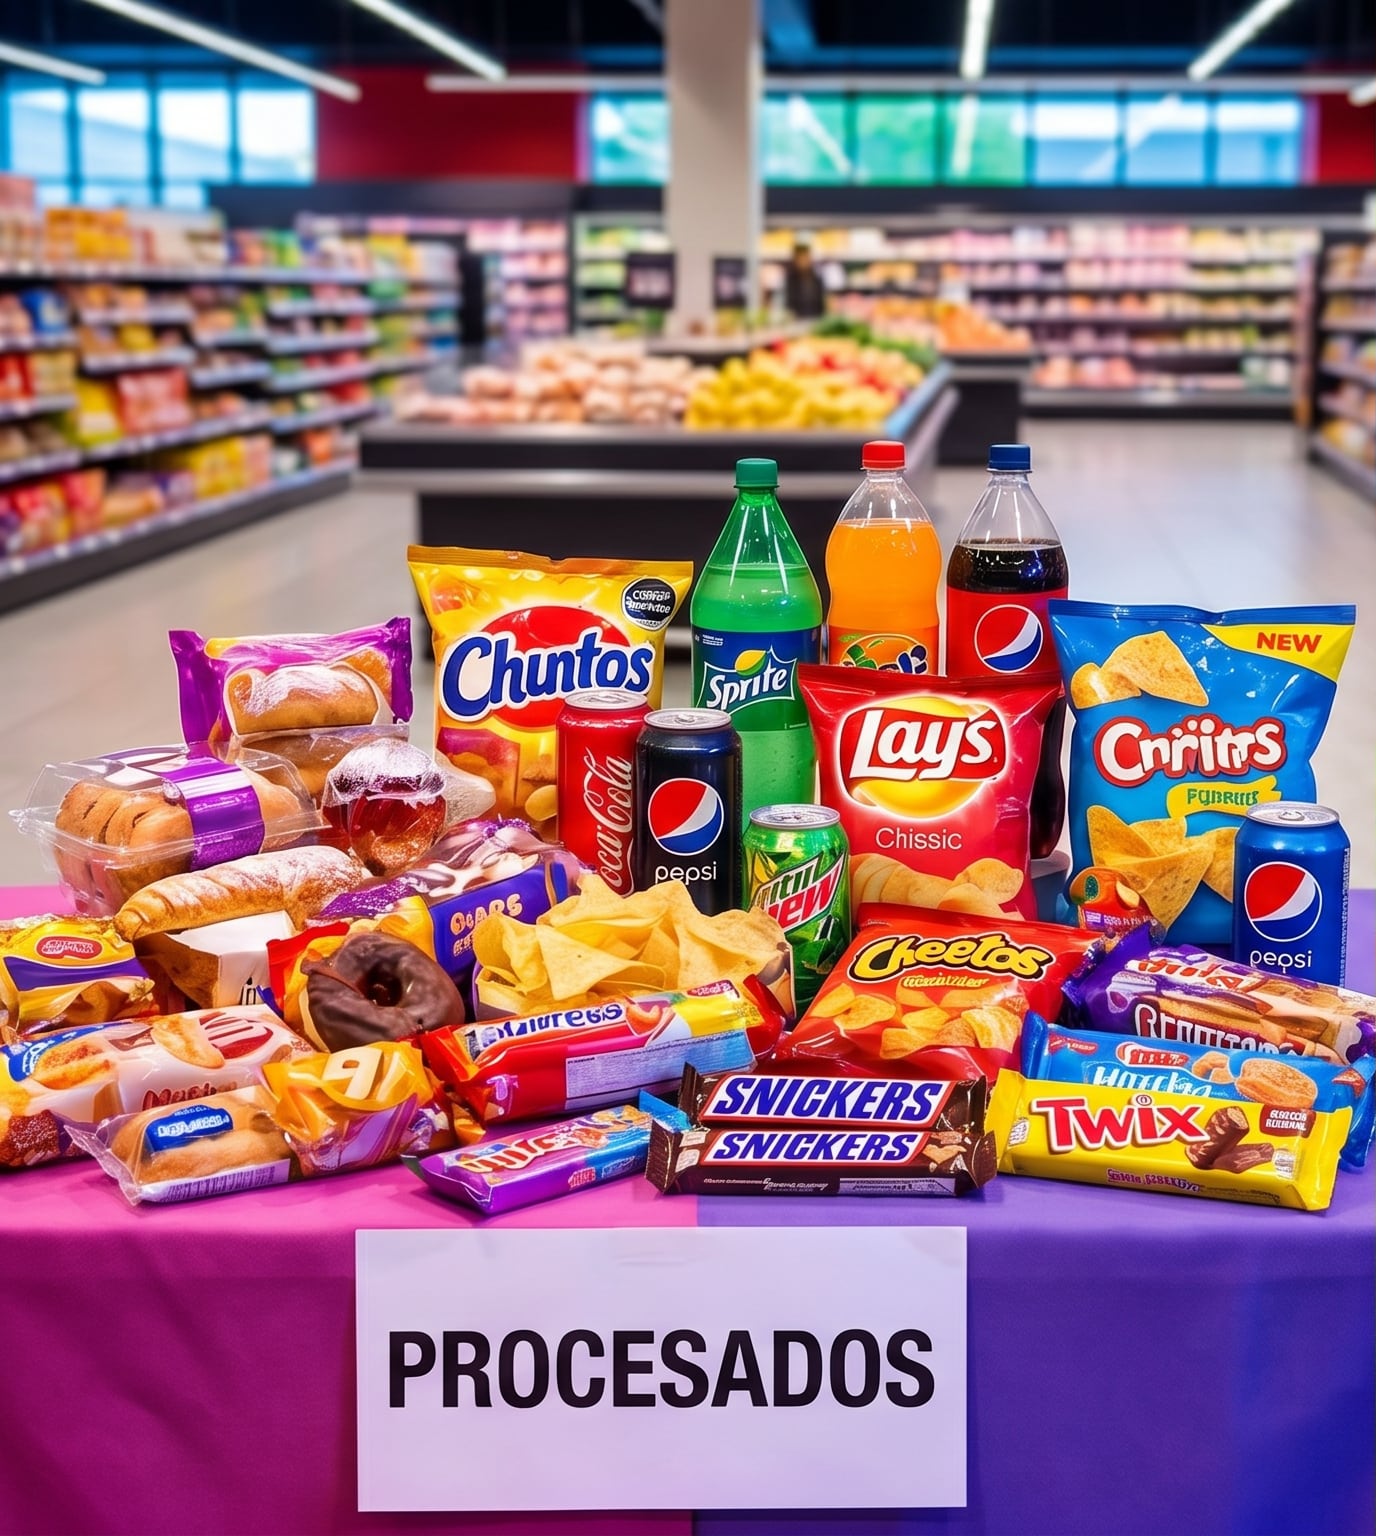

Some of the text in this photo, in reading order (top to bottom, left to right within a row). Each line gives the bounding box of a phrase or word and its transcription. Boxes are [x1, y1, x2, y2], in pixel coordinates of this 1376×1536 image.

[1257, 632, 1322, 653] NEW
[706, 658, 788, 711] Sprite
[655, 861, 717, 885] pepsi
[851, 934, 1053, 981] Cheetos
[713, 1077, 944, 1121] SNICKERS
[1032, 1094, 1205, 1150] Twix
[713, 1133, 919, 1161] SNICKERS
[388, 1329, 936, 1409] PROCESADOS
